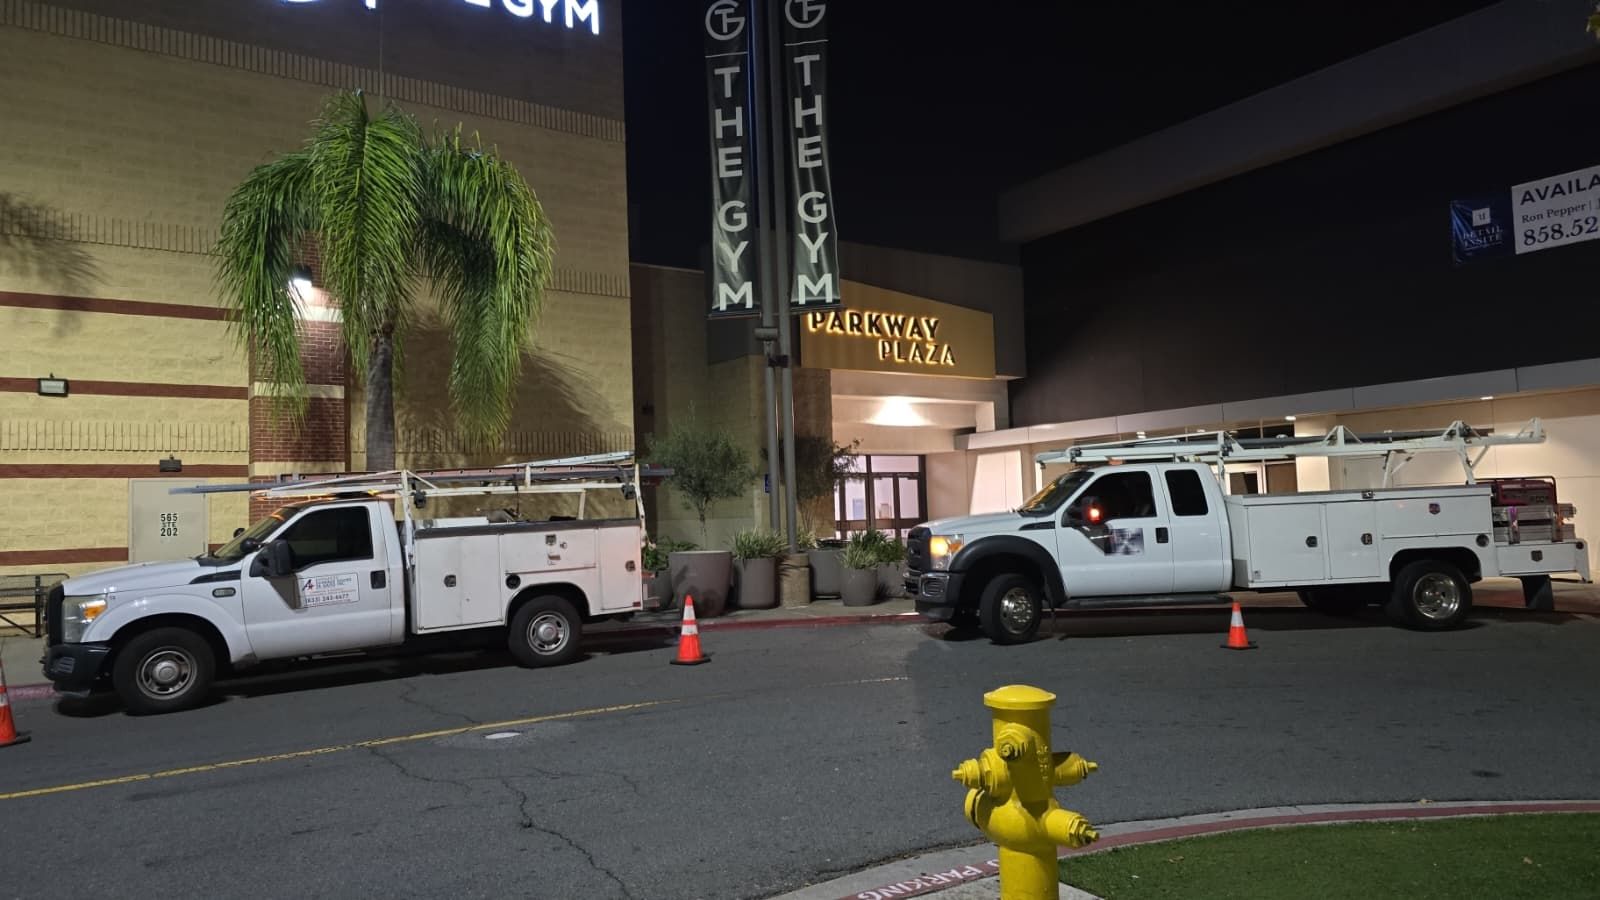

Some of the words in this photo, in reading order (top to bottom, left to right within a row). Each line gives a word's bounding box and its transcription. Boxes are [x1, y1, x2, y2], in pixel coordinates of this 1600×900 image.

[714, 66, 744, 178] THE
[793, 53, 824, 169] THE
[1521, 211, 1544, 224] Ron
[1547, 204, 1587, 219] Pepper
[718, 200, 753, 312] GYM
[797, 191, 833, 305] GYM
[807, 310, 940, 341] PARKWAY
[878, 338, 956, 366] PLAZA
[160, 513, 178, 522] 565
[160, 527, 178, 537] 202
[857, 865, 984, 900] PARKING
